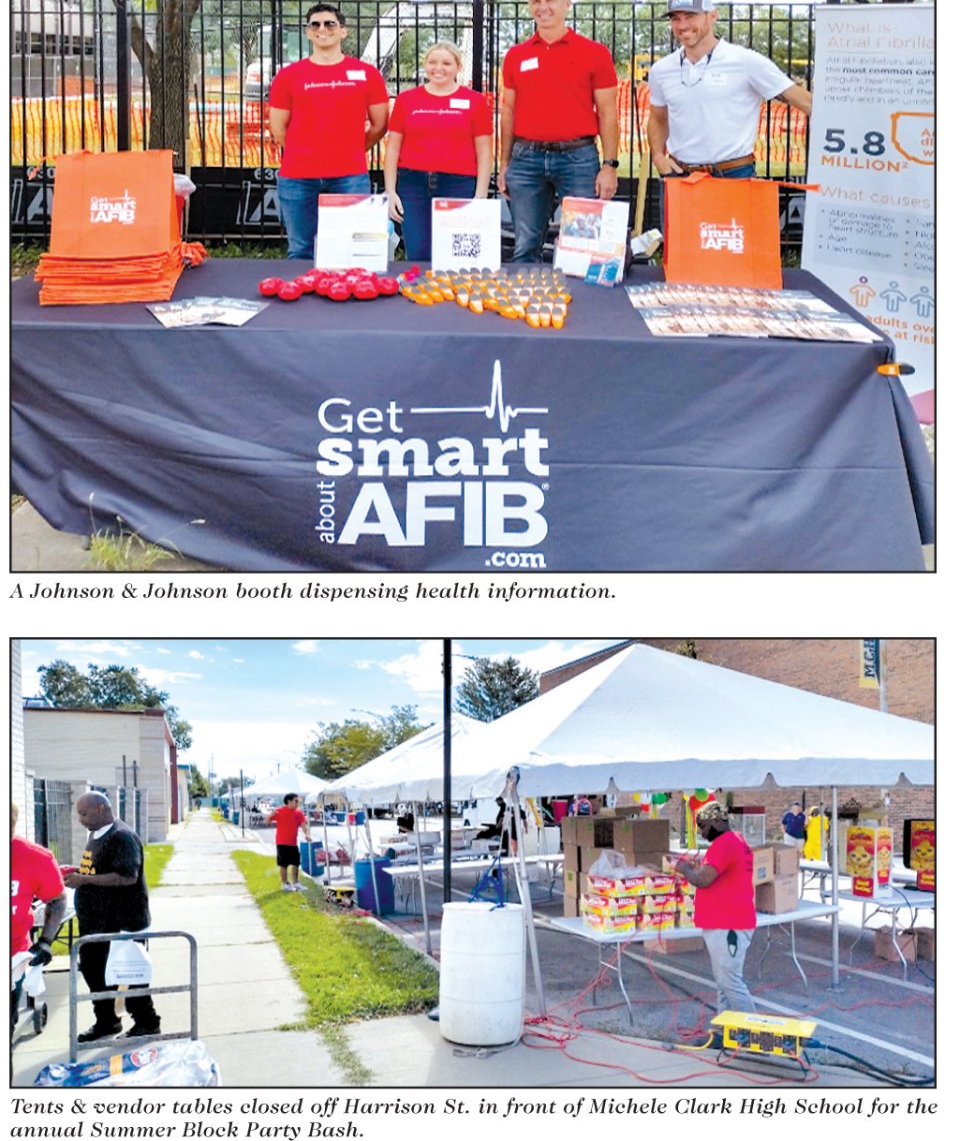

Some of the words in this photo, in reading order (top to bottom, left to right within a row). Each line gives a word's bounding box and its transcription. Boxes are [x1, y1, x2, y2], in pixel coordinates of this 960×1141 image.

[828, 21, 871, 34] What
[879, 22, 891, 34] is
[826, 36, 872, 48] Atrial
[843, 66, 866, 74] most
[824, 128, 886, 157] 5.8
[820, 186, 864, 201] What
[870, 194, 931, 209] causes
[89, 200, 137, 211] smart
[96, 210, 136, 223] AFIB
[700, 228, 744, 239] smart
[705, 238, 744, 251] AFIB
[866, 315, 908, 329] adults
[894, 330, 908, 340] at
[317, 397, 404, 434] Get
[316, 428, 550, 477] smart
[315, 480, 336, 544] about
[484, 550, 547, 568] .com
[8, 583, 24, 599] A
[29, 582, 114, 599] Johnson
[121, 583, 137, 599] &
[142, 582, 227, 599] Johnson
[236, 582, 292, 599] booth
[299, 582, 409, 602] dispensing
[415, 582, 479, 599] health
[488, 581, 616, 603] information.
[10, 1121, 84, 1138] annual
[90, 1122, 177, 1138] Summer
[182, 1121, 239, 1138] Block
[246, 1121, 301, 1141] Party
[308, 1121, 364, 1138] Bash.
